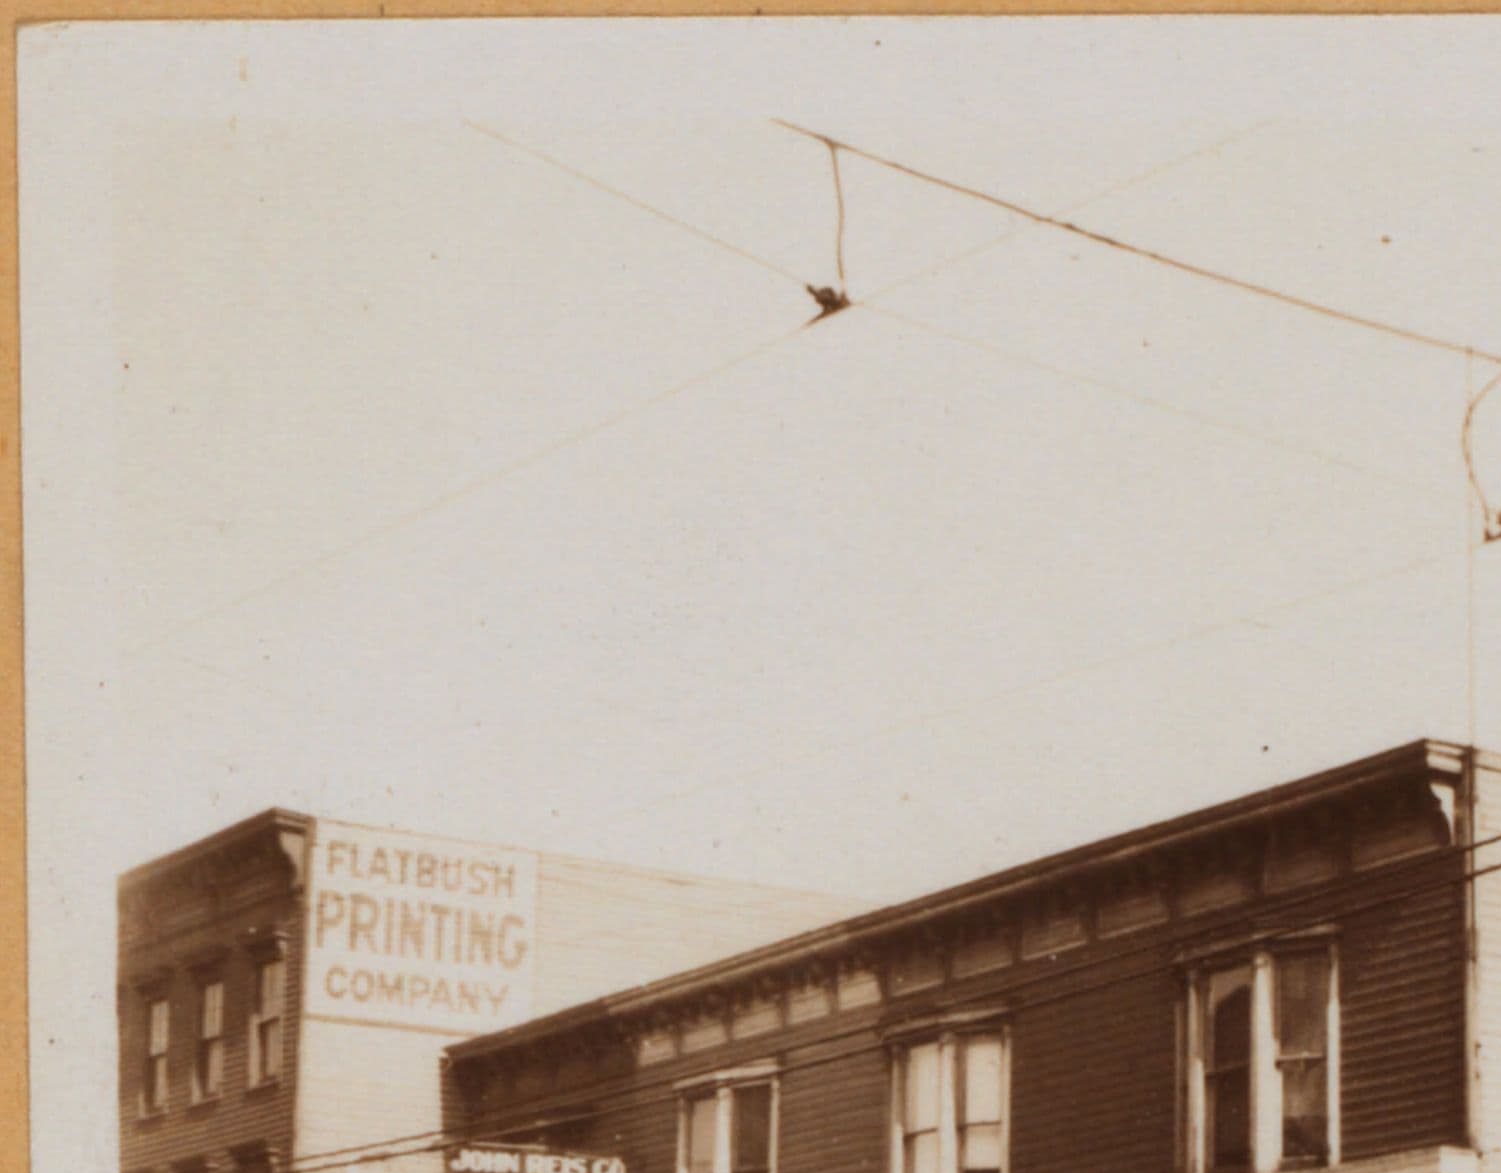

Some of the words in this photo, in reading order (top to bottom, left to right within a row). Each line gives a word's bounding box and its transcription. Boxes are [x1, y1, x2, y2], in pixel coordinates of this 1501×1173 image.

[326, 839, 516, 898] FLATBUSH
[314, 888, 529, 971] PRINTING
[324, 964, 510, 1017] COMPANY
